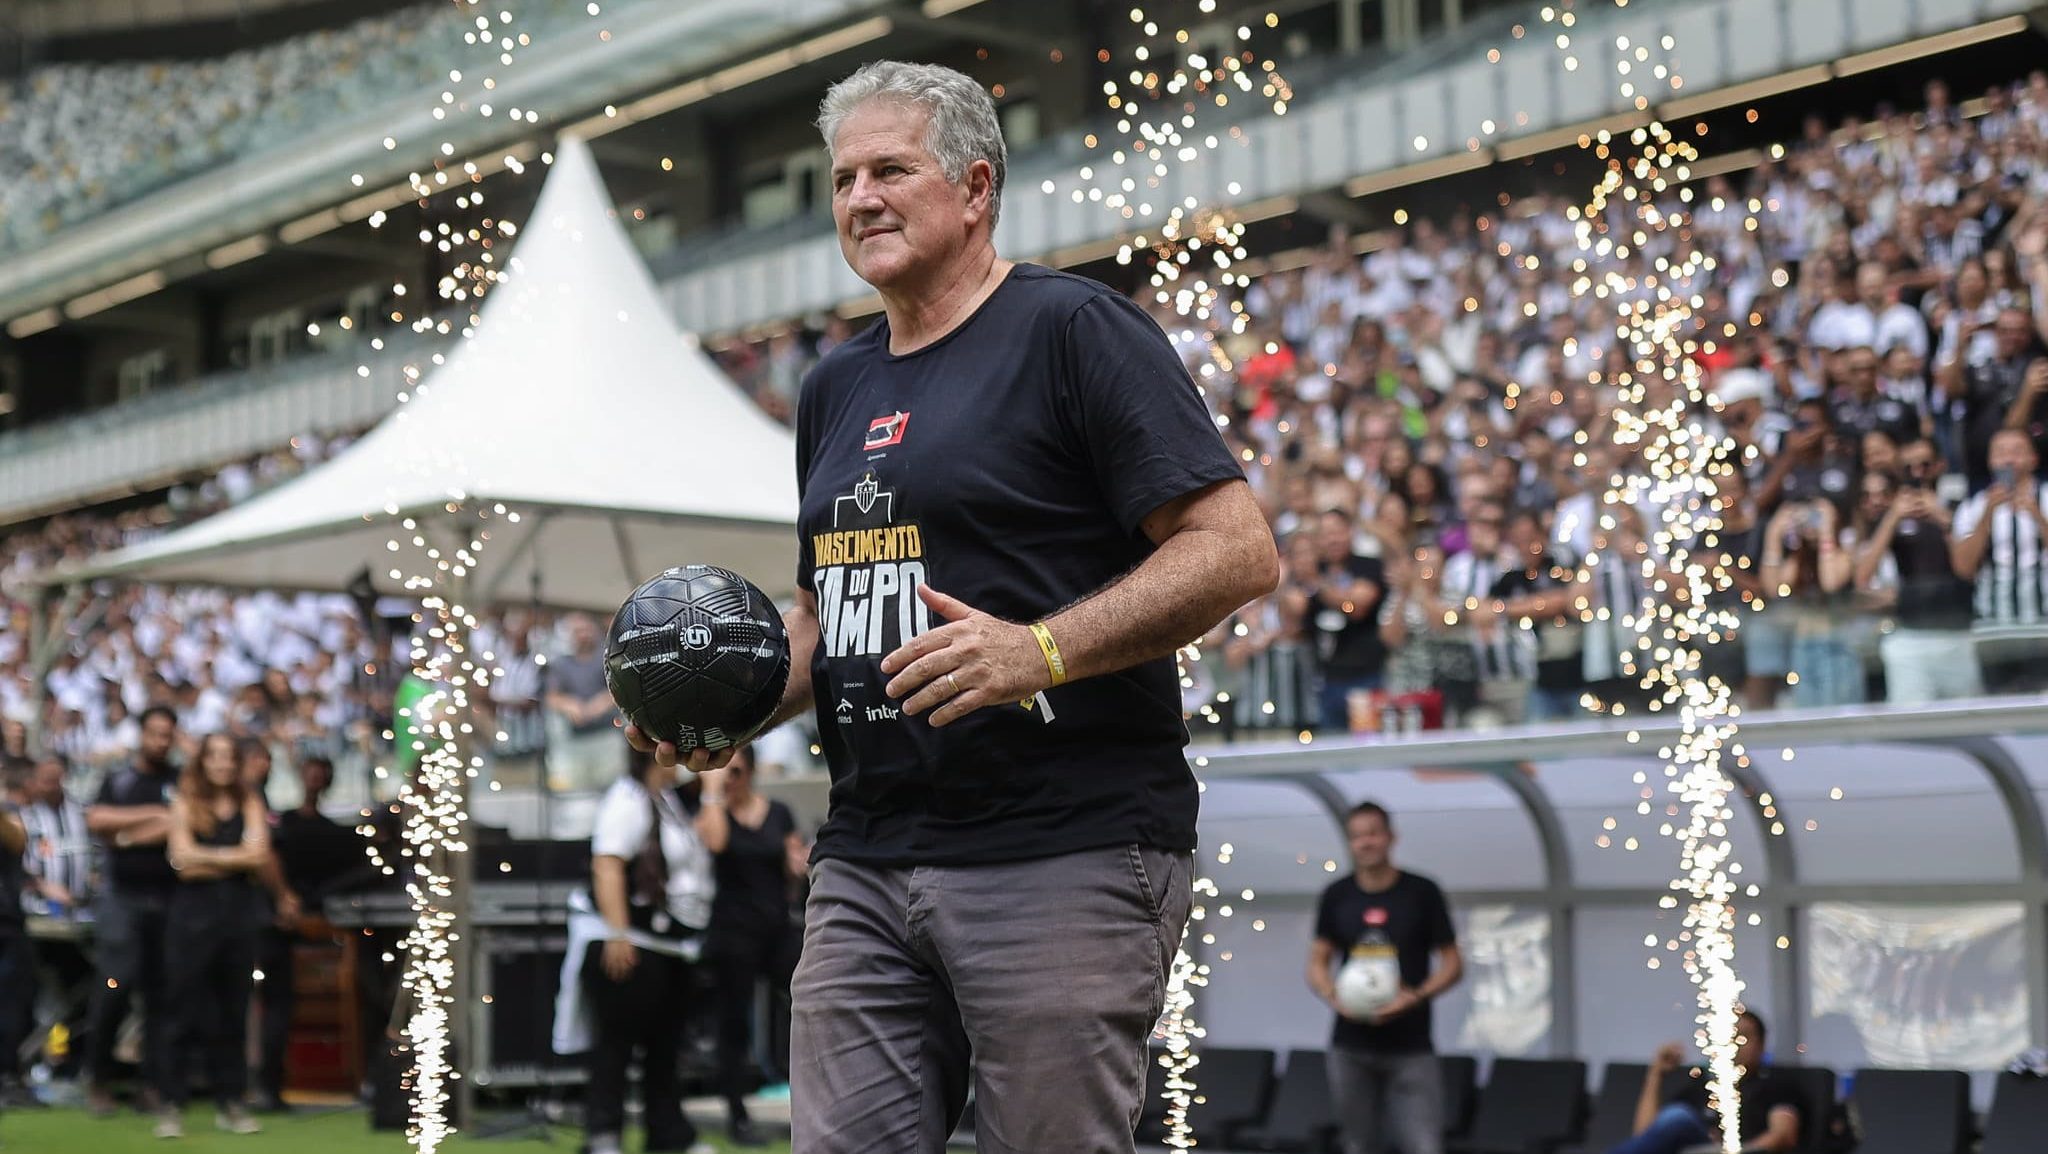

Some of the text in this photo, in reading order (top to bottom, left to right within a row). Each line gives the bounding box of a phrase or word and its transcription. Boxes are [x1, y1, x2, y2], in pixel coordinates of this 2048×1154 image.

[813, 525, 921, 567] NASCIMENTO
[849, 569, 870, 596] DO
[814, 561, 929, 657] CAMPO
[1051, 653, 1064, 675] VIP
